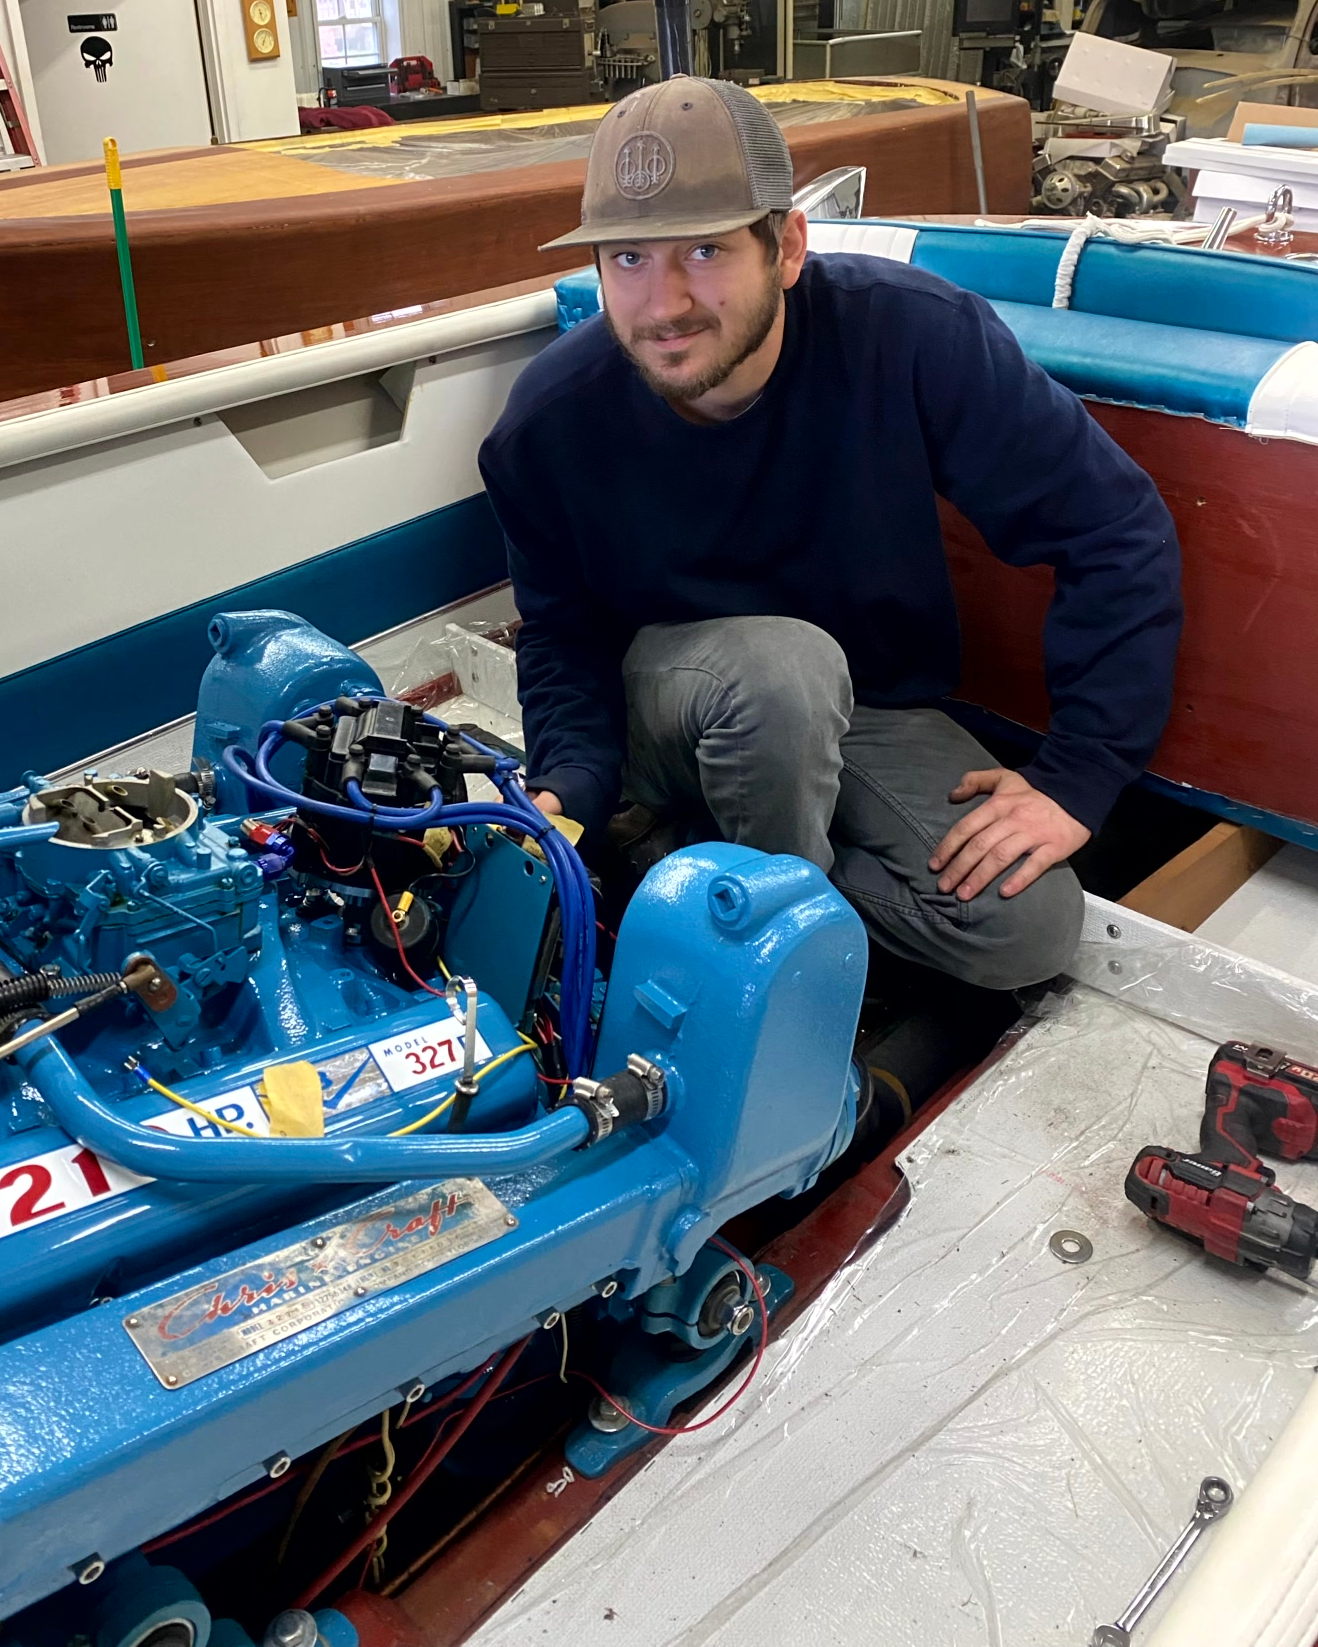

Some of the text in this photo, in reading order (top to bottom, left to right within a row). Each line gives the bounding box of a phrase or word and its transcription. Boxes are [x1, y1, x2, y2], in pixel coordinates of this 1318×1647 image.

[383, 1036, 428, 1057] MODEL
[405, 1038, 456, 1075] 327
[158, 1274, 299, 1341] Chris
[346, 1191, 475, 1254] Craft
